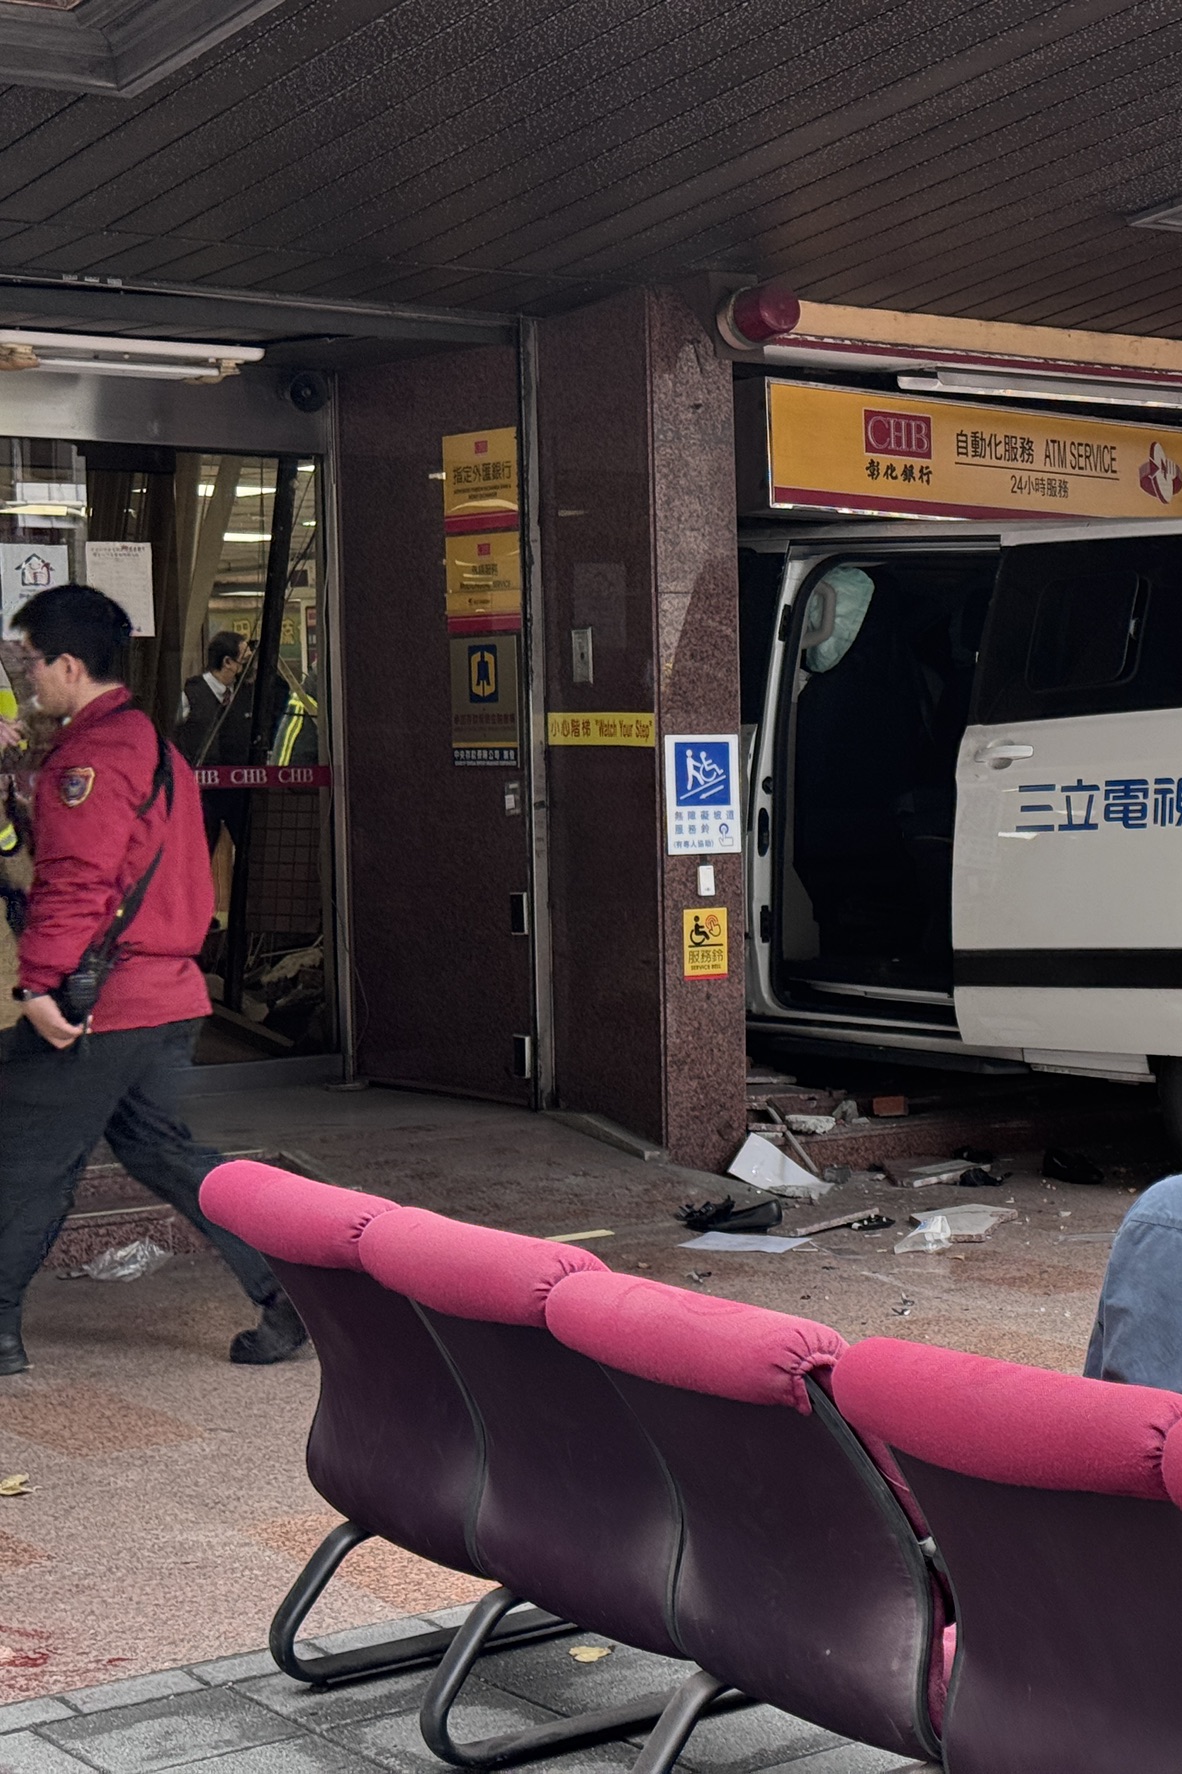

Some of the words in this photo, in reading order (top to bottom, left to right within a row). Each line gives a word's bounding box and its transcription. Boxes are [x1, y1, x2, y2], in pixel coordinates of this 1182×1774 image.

[867, 416, 929, 453] CHB
[956, 429, 1034, 464] 自動化服務
[1044, 438, 1067, 469] ATM
[1069, 441, 1117, 474] SERVICE
[865, 458, 932, 485] 彰化銀行
[1010, 474, 1069, 498] 24小時服務
[195, 769, 219, 785] HB
[231, 768, 267, 784] CHB
[278, 768, 313, 783] CHB
[674, 810, 734, 821] 無障礙坡道
[688, 949, 723, 964] 服務鈴
